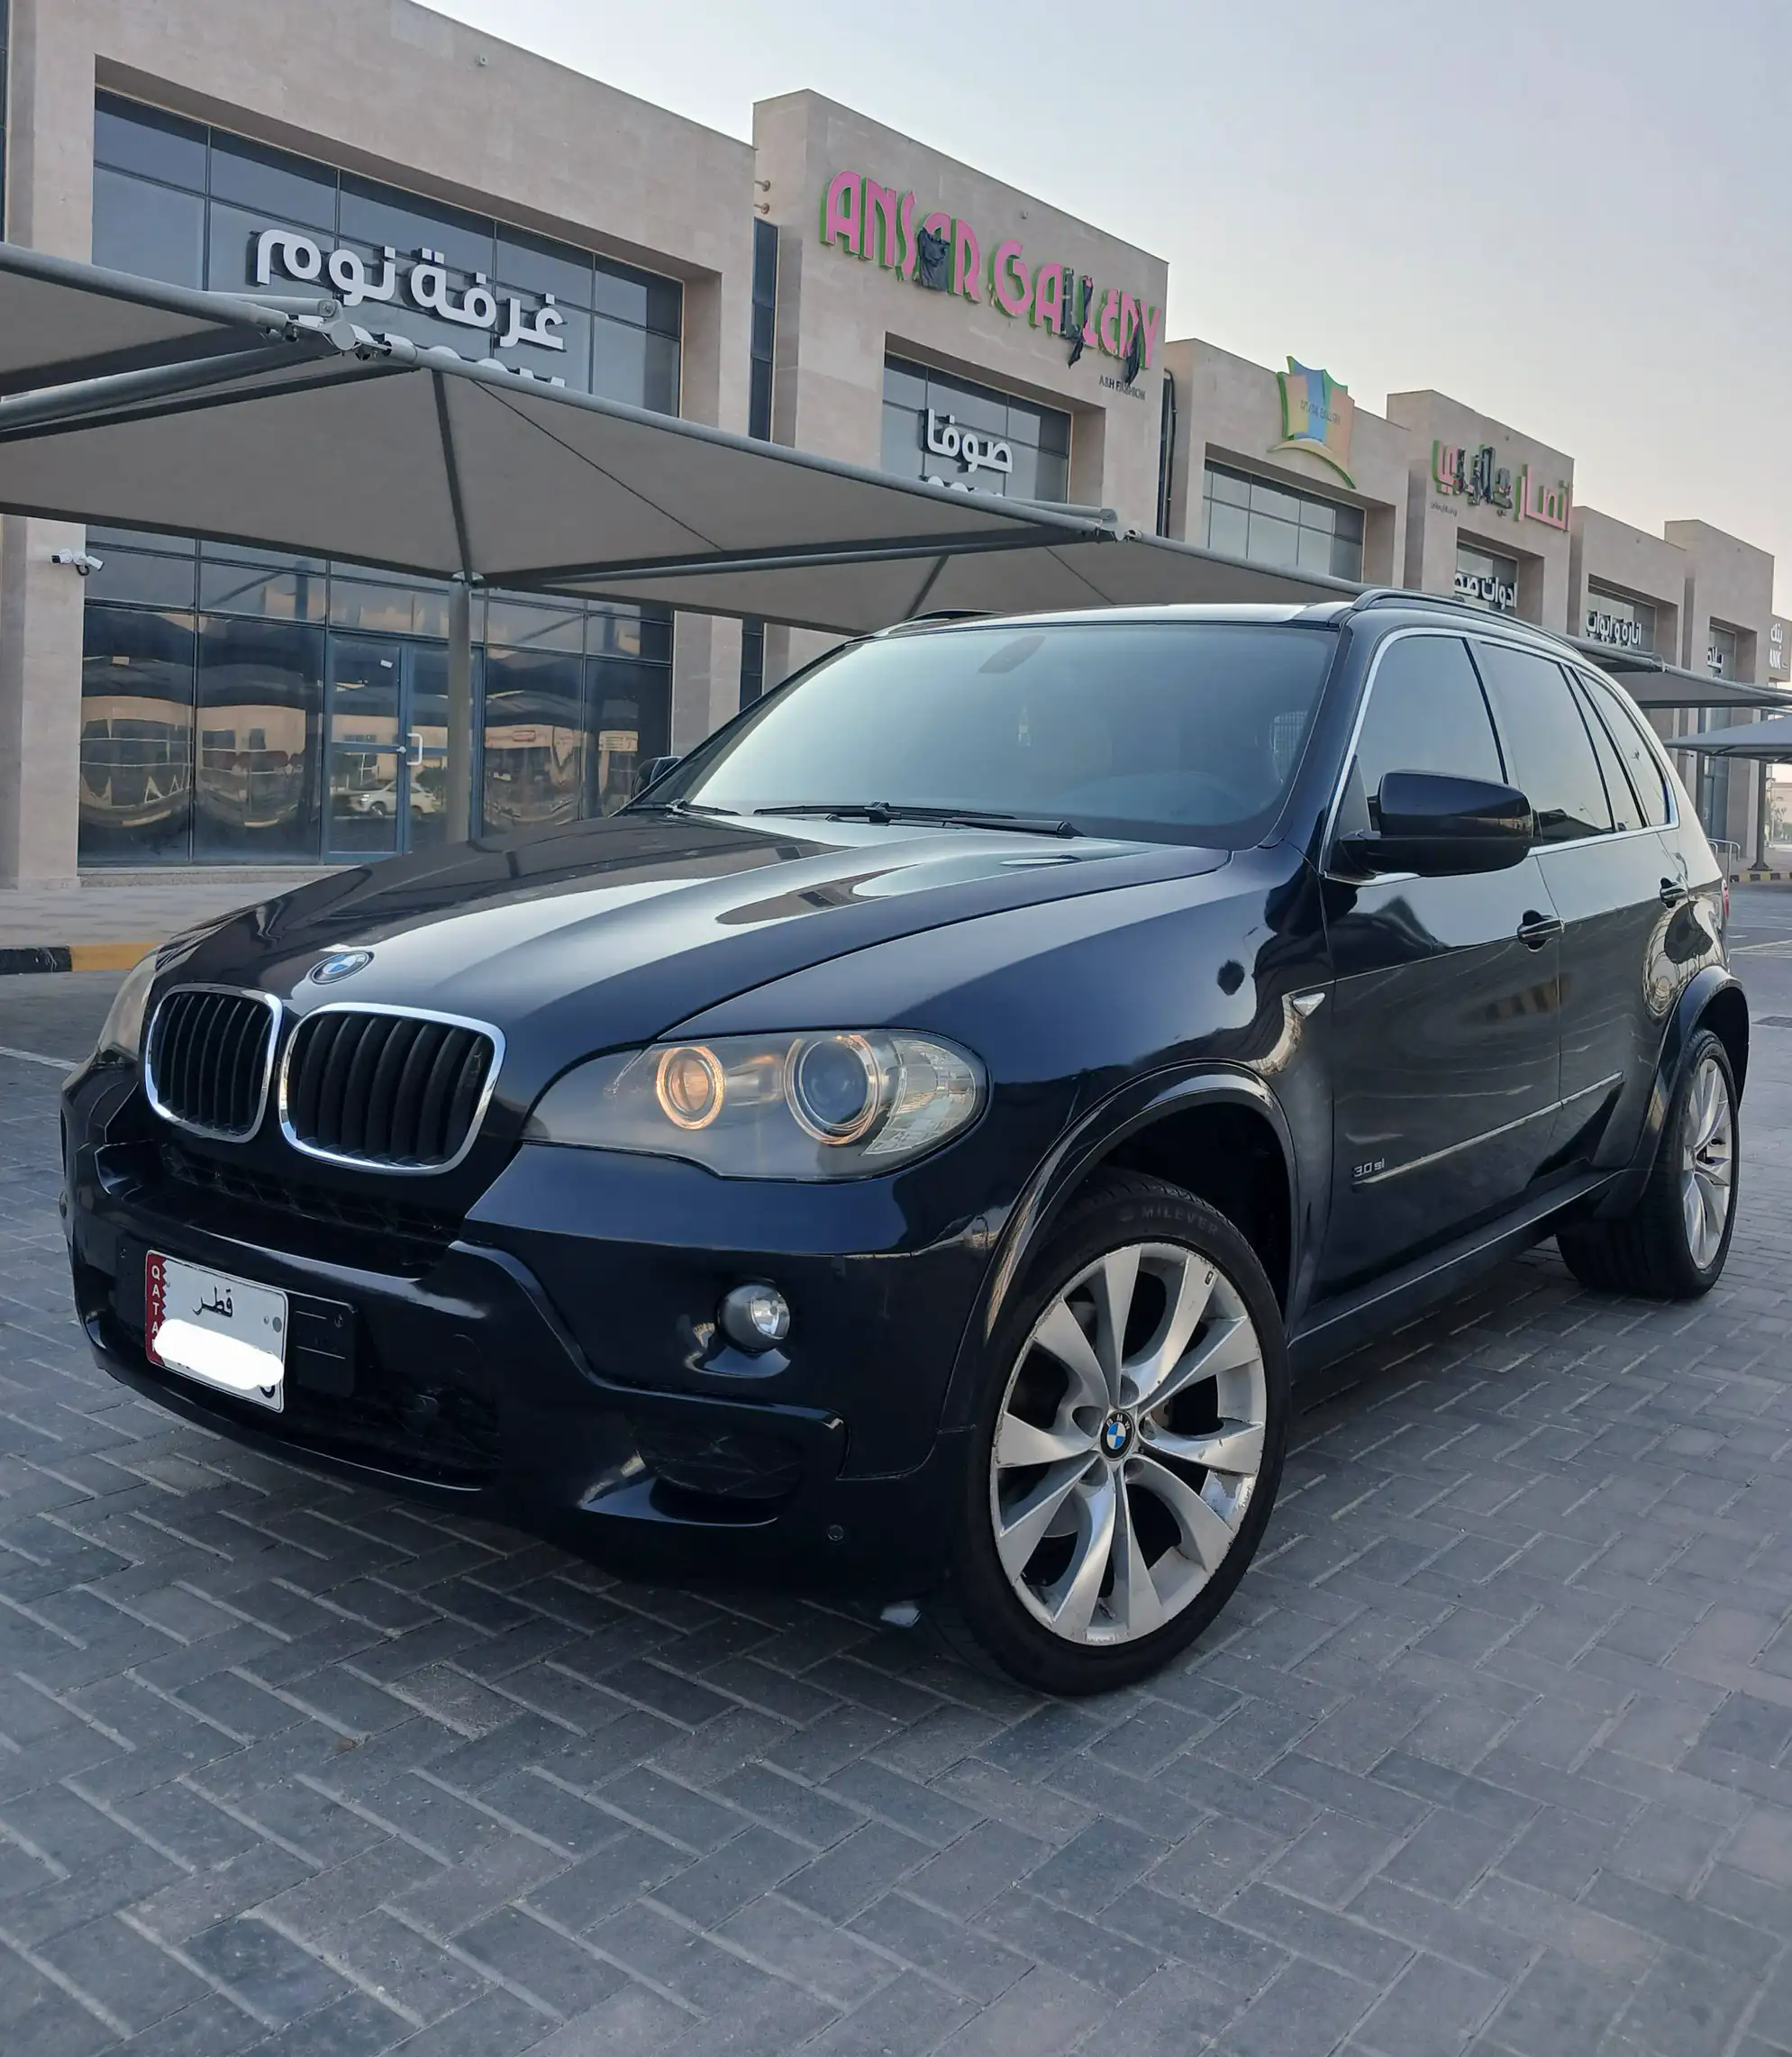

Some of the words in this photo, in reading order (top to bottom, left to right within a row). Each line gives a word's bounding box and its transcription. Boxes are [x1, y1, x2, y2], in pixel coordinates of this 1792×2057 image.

[256, 229, 395, 307] نوم
[411, 247, 565, 350] غرفة
[991, 240, 1160, 369] GALERY
[926, 408, 1013, 473] صوفا
[150, 1264, 161, 1352] QATA
[192, 1283, 234, 1318] قطر
[1106, 1414, 1131, 1430] BMW
